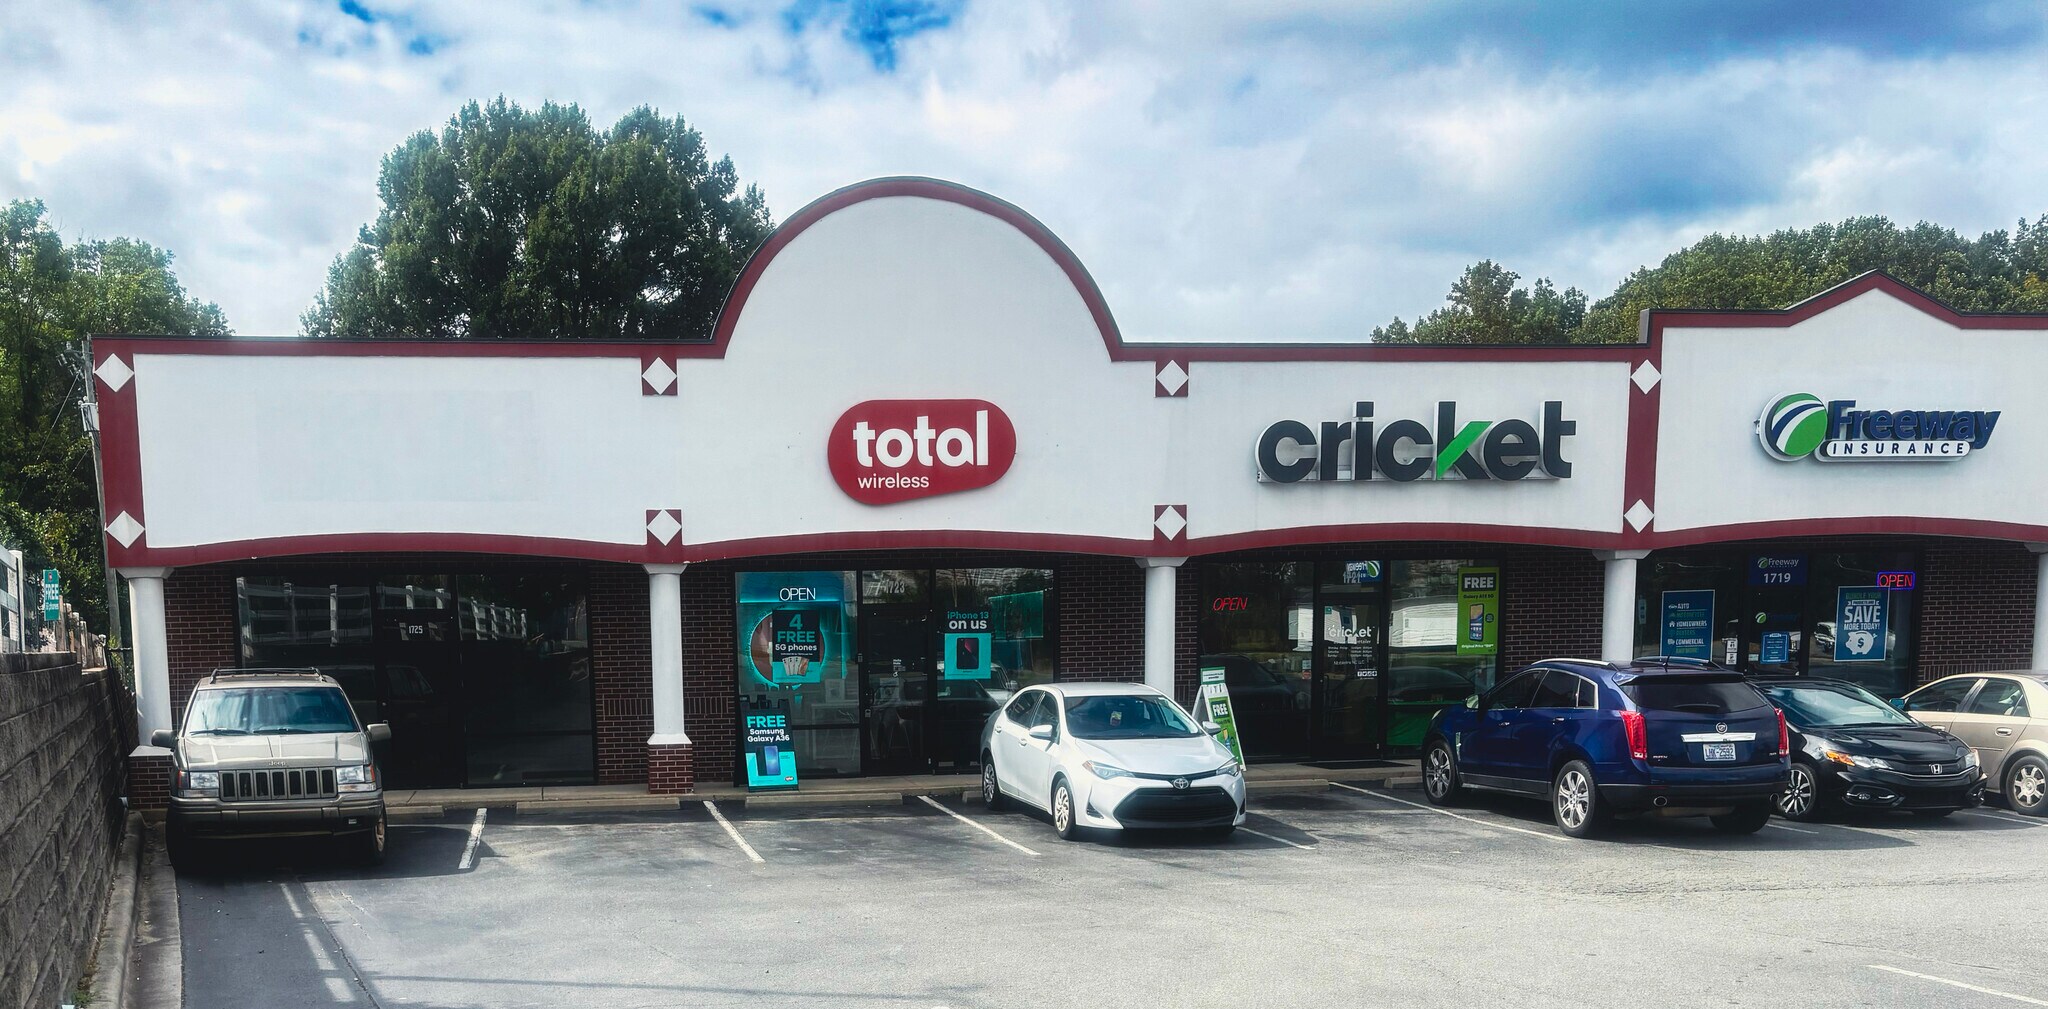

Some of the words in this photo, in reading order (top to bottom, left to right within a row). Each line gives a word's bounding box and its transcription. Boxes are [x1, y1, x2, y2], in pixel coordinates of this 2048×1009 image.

[1826, 400, 2002, 449] Freeway
[853, 410, 989, 468] total
[1256, 400, 1577, 483] cricket
[1832, 443, 1964, 455] INSURANCE
[858, 472, 930, 489] wireless
[1768, 558, 1799, 567] Freeway
[1464, 577, 1494, 589] FREE
[1763, 572, 1791, 583] 1719
[1880, 574, 1913, 587] OPEN
[45, 584, 59, 600] FREE
[780, 588, 816, 601] OPEN
[1213, 598, 1249, 611] OPEN
[947, 611, 978, 619] iPhone
[1844, 606, 1881, 623] SAVE
[789, 614, 803, 630] 4
[948, 621, 967, 630] on
[970, 620, 988, 630] us
[409, 625, 423, 634] 1725
[1328, 626, 1372, 638] cricket
[777, 631, 816, 643] FREE
[775, 643, 786, 651] 5G
[788, 644, 817, 652] phones
[1212, 703, 1228, 717] FREE
[746, 715, 786, 728] FREE
